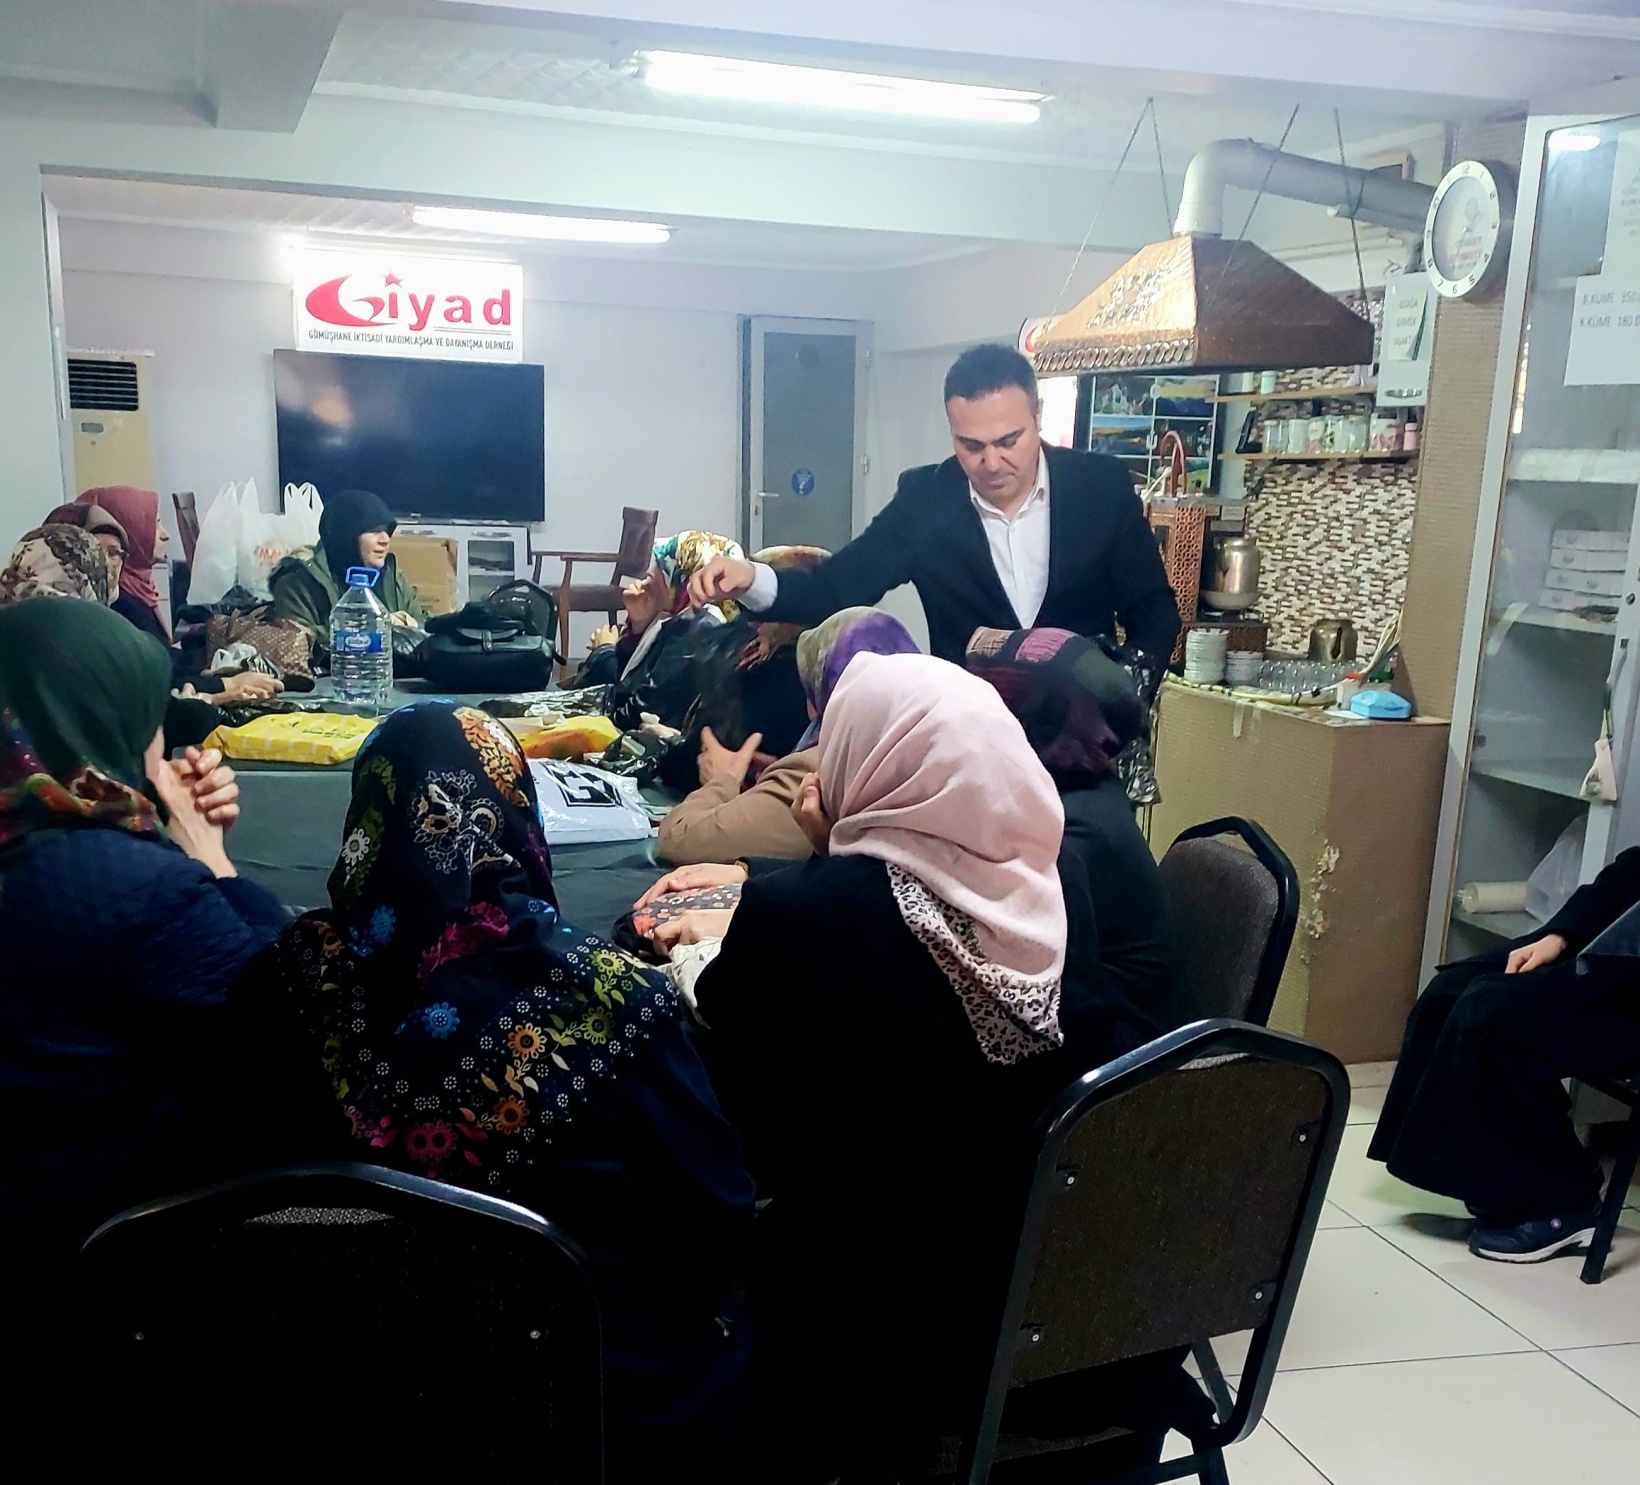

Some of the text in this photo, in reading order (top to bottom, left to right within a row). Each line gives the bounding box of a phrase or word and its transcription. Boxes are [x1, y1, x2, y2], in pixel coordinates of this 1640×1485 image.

[308, 328, 352, 343] GÜMÜŞHANE
[385, 334, 433, 347] YARDIMLAŞMA
[434, 337, 444, 347] VE
[445, 338, 483, 351] DAYANIŞMA
